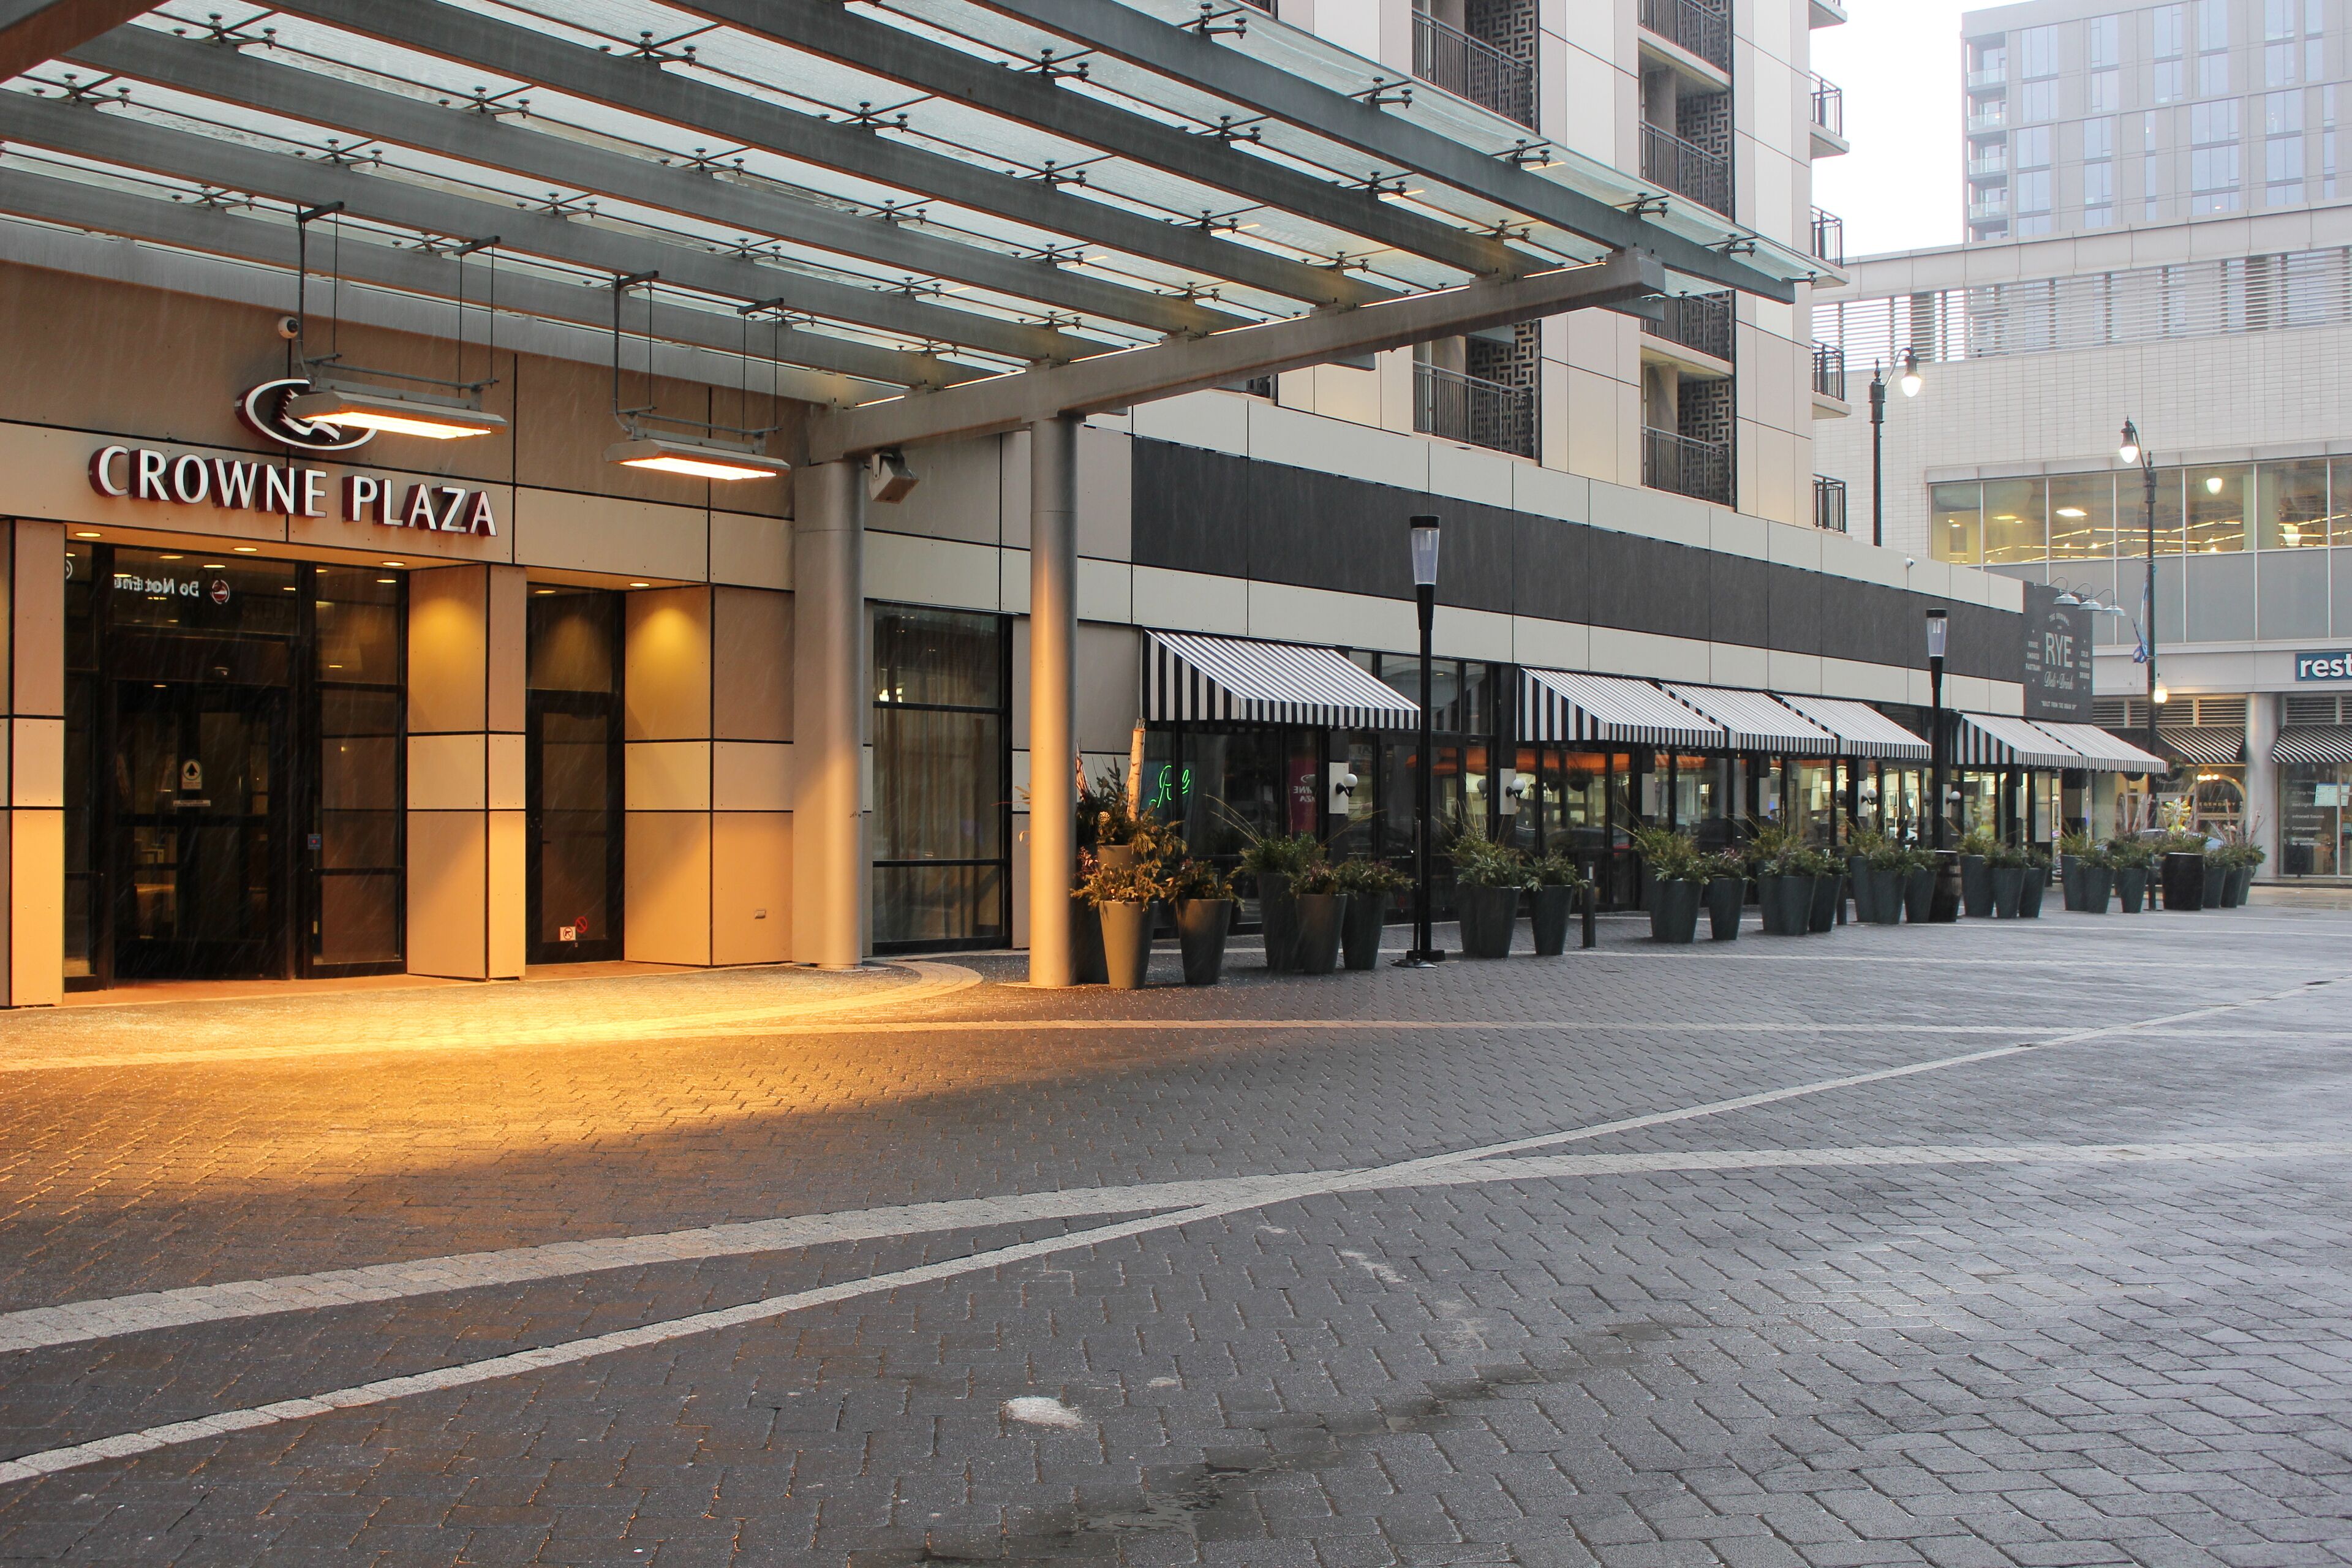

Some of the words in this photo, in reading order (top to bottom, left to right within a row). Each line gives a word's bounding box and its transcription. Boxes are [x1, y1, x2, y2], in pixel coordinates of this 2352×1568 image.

[90, 445, 327, 518] CROWNE
[343, 475, 497, 537] PLAZA
[2045, 632, 2073, 668] RYE
[2026, 663, 2041, 671] PASTRAMI
[2059, 673, 2073, 690] Drink
